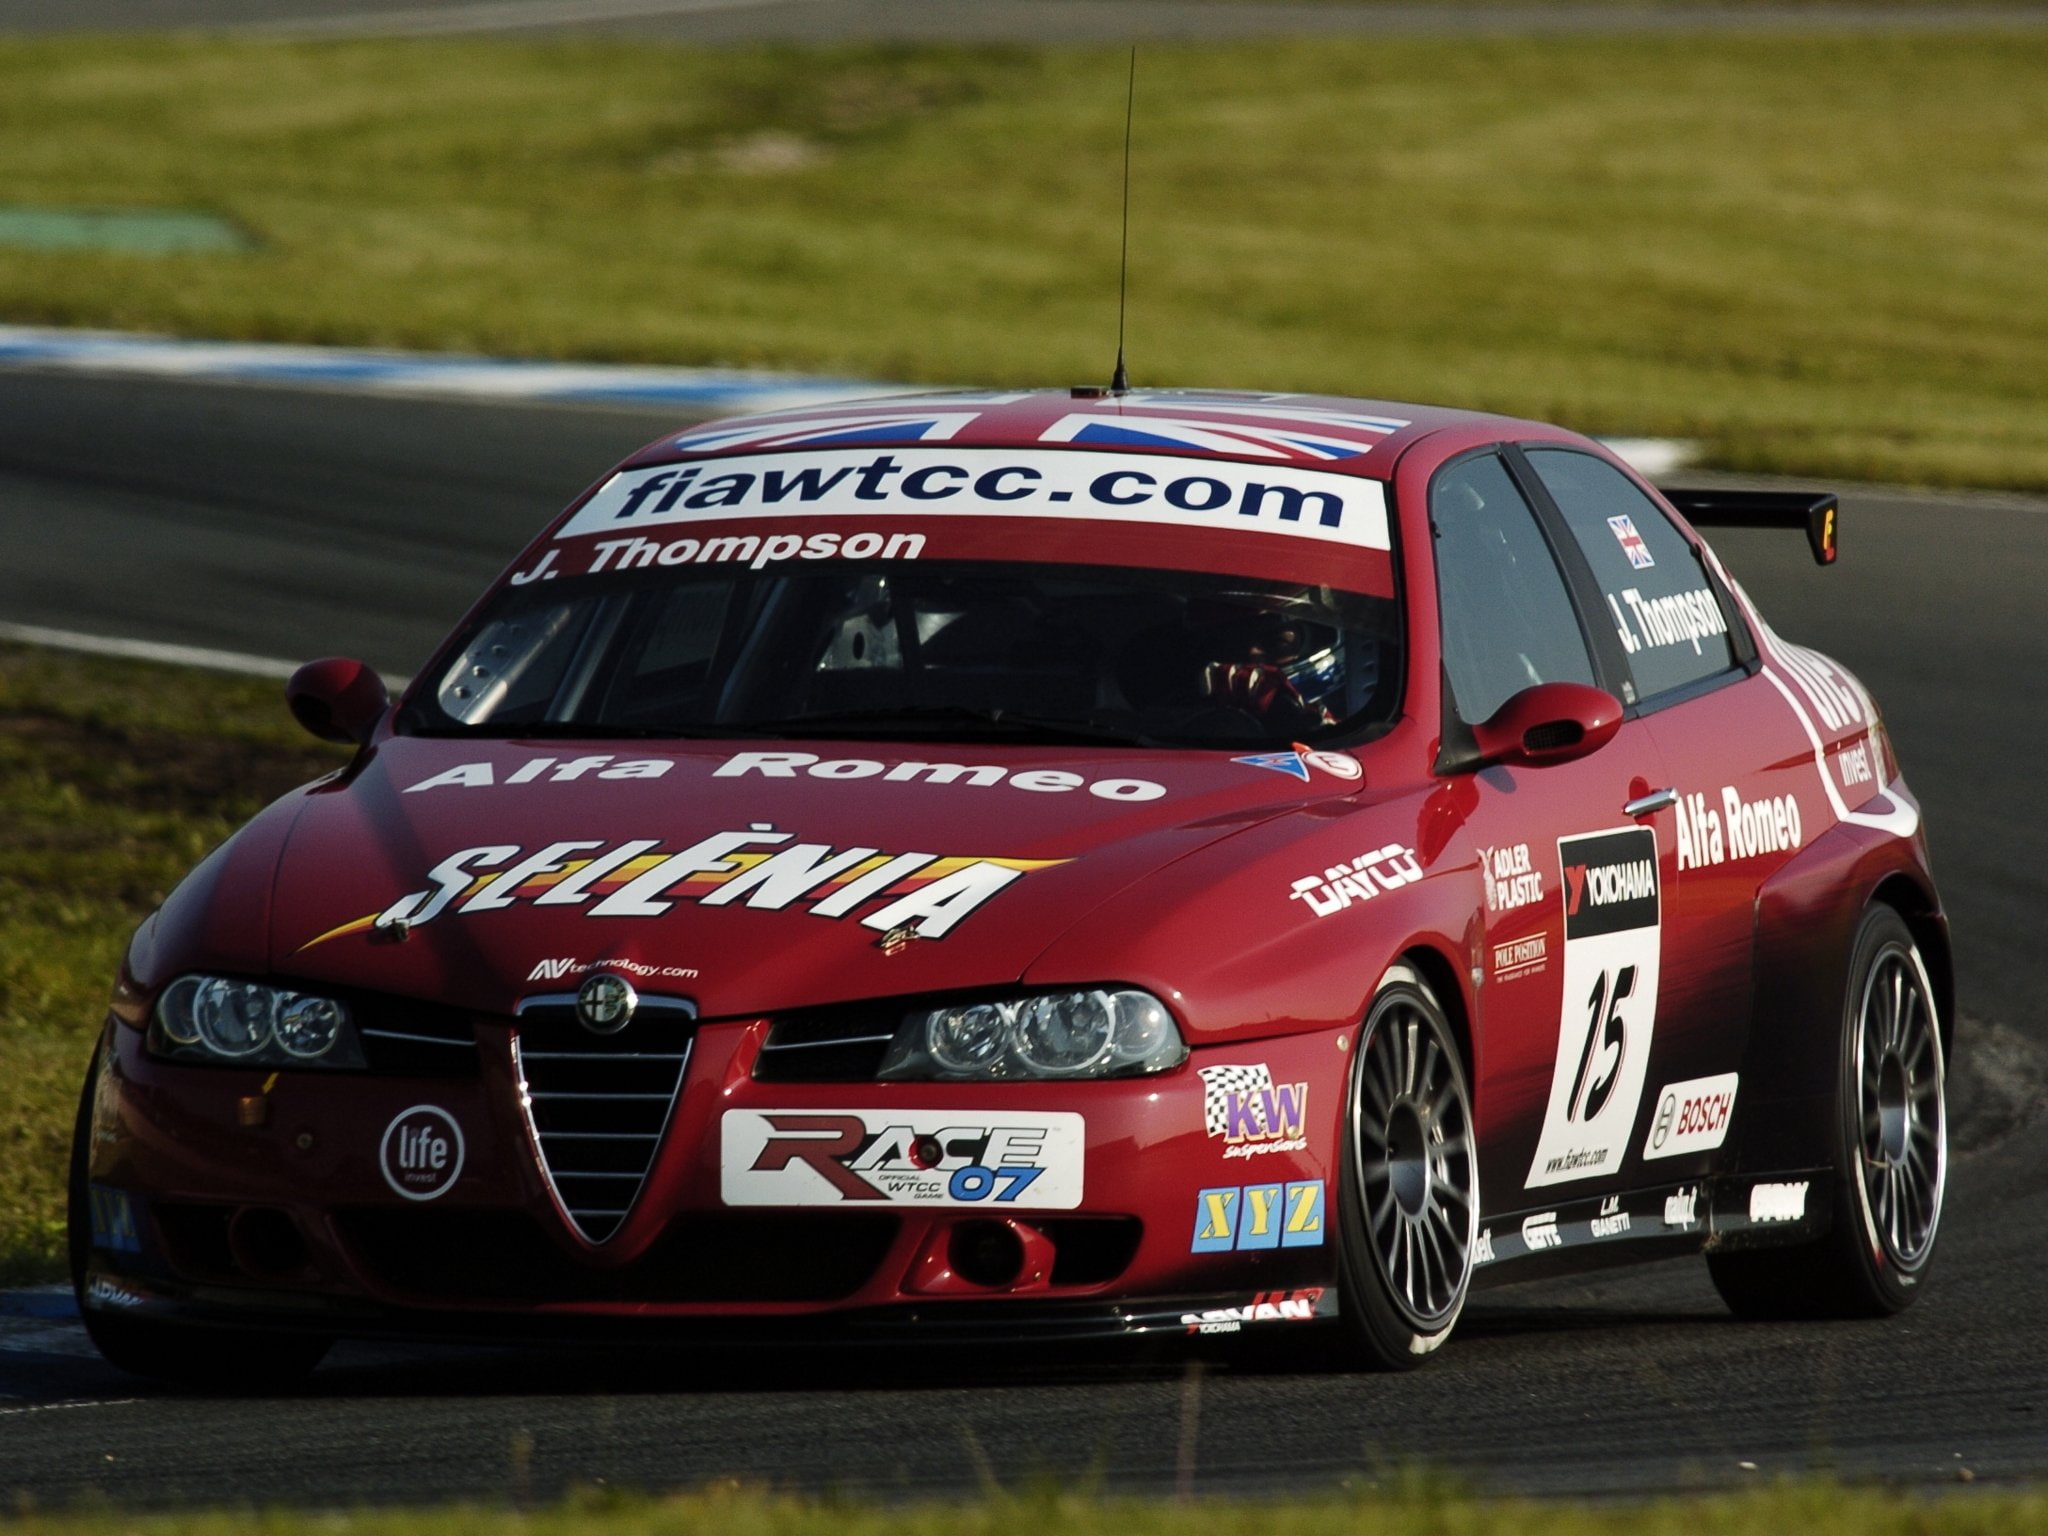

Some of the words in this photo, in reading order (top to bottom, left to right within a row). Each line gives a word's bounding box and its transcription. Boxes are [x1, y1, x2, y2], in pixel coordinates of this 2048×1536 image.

[615, 454, 1344, 528] fiawtcc.com
[511, 549, 558, 587] J.
[594, 530, 927, 571] Thompson
[1607, 593, 1641, 654] J.
[1622, 588, 1728, 656] Thompson
[403, 755, 674, 794] Alfa
[712, 751, 1168, 802] Romeo
[1676, 791, 1724, 870] Alfa
[1721, 786, 1802, 859] Romeo
[1289, 843, 1424, 918] DAYCO
[1494, 843, 1531, 879] ADLER
[1586, 859, 1655, 906] YOKOHAMA
[1497, 872, 1544, 911] PLASTIC
[1566, 964, 1639, 1124] 15
[1225, 1082, 1308, 1142] KW
[1677, 1093, 1732, 1136] BOSCH
[399, 1125, 448, 1169] life
[748, 1115, 1048, 1201] RACE
[888, 1182, 942, 1193] WTCC
[948, 1166, 1048, 1201] 07
[1200, 1185, 1320, 1239] XYZ
